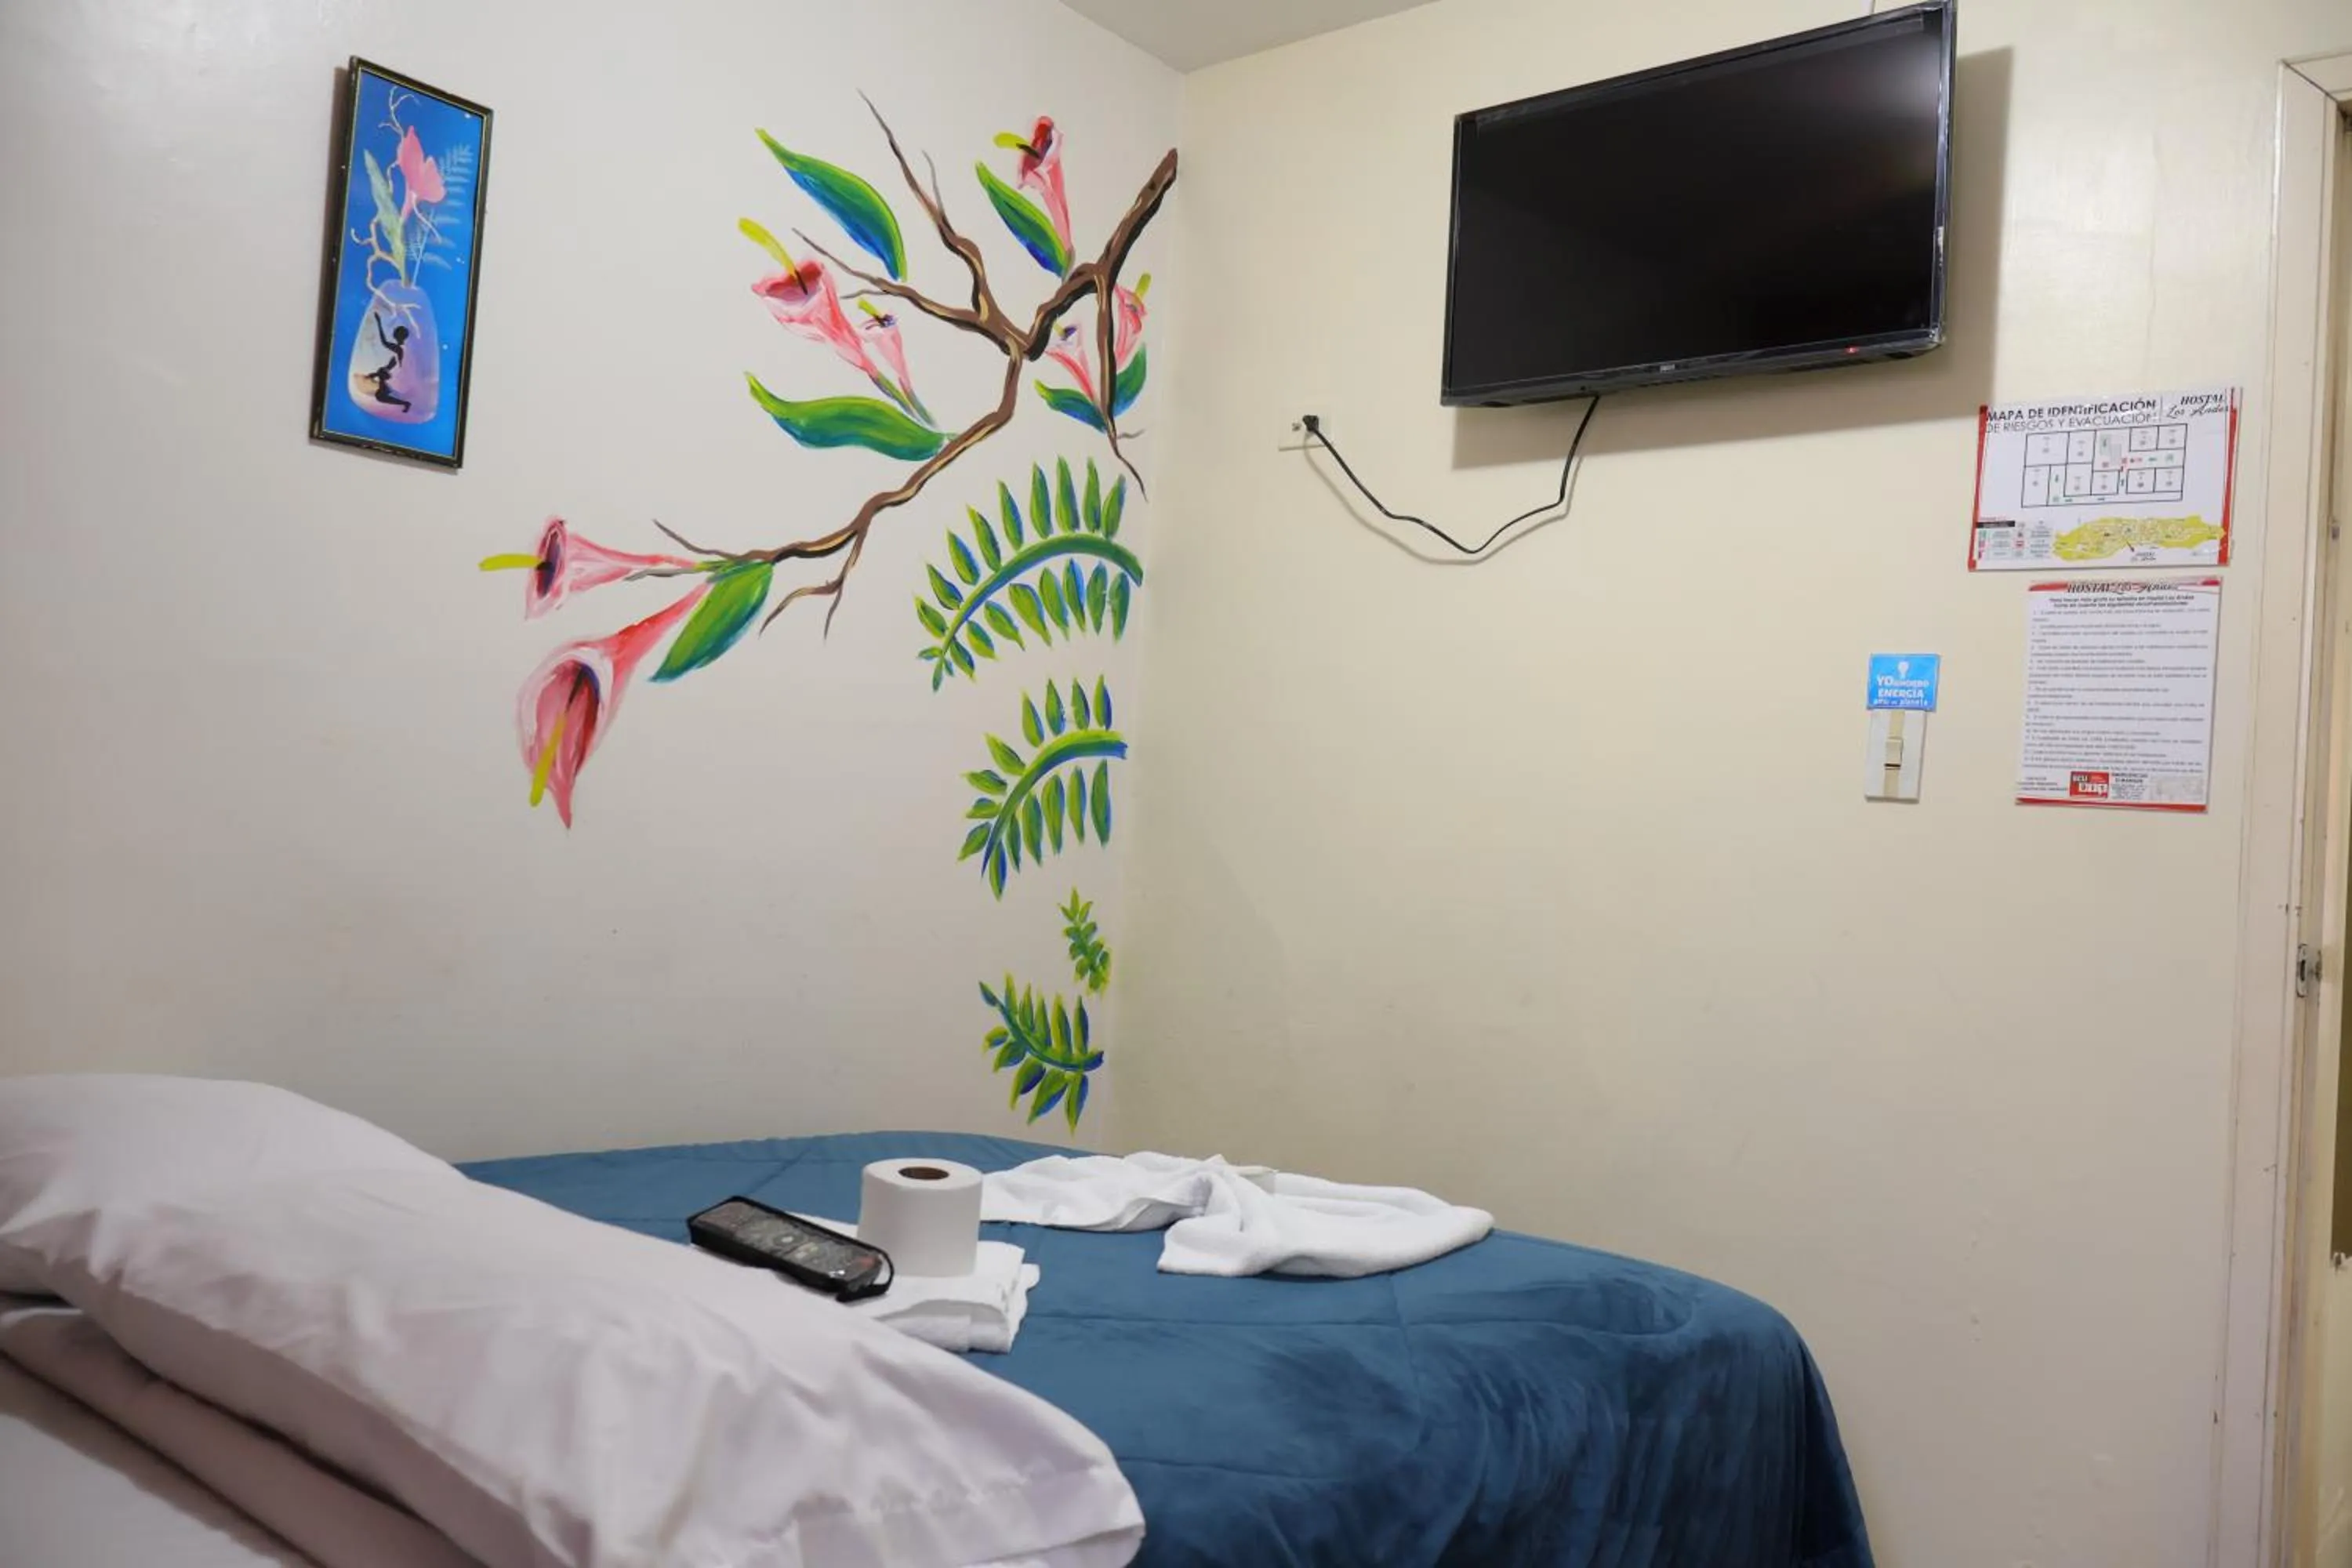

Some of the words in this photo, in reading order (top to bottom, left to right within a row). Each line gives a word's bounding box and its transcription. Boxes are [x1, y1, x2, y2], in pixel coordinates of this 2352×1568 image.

[1987, 409, 2024, 421] MAPA
[2028, 408, 2043, 419] DE
[2003, 419, 2053, 431] RIESGOS
[2058, 417, 2066, 427] Y
[1877, 674, 1893, 686] YO
